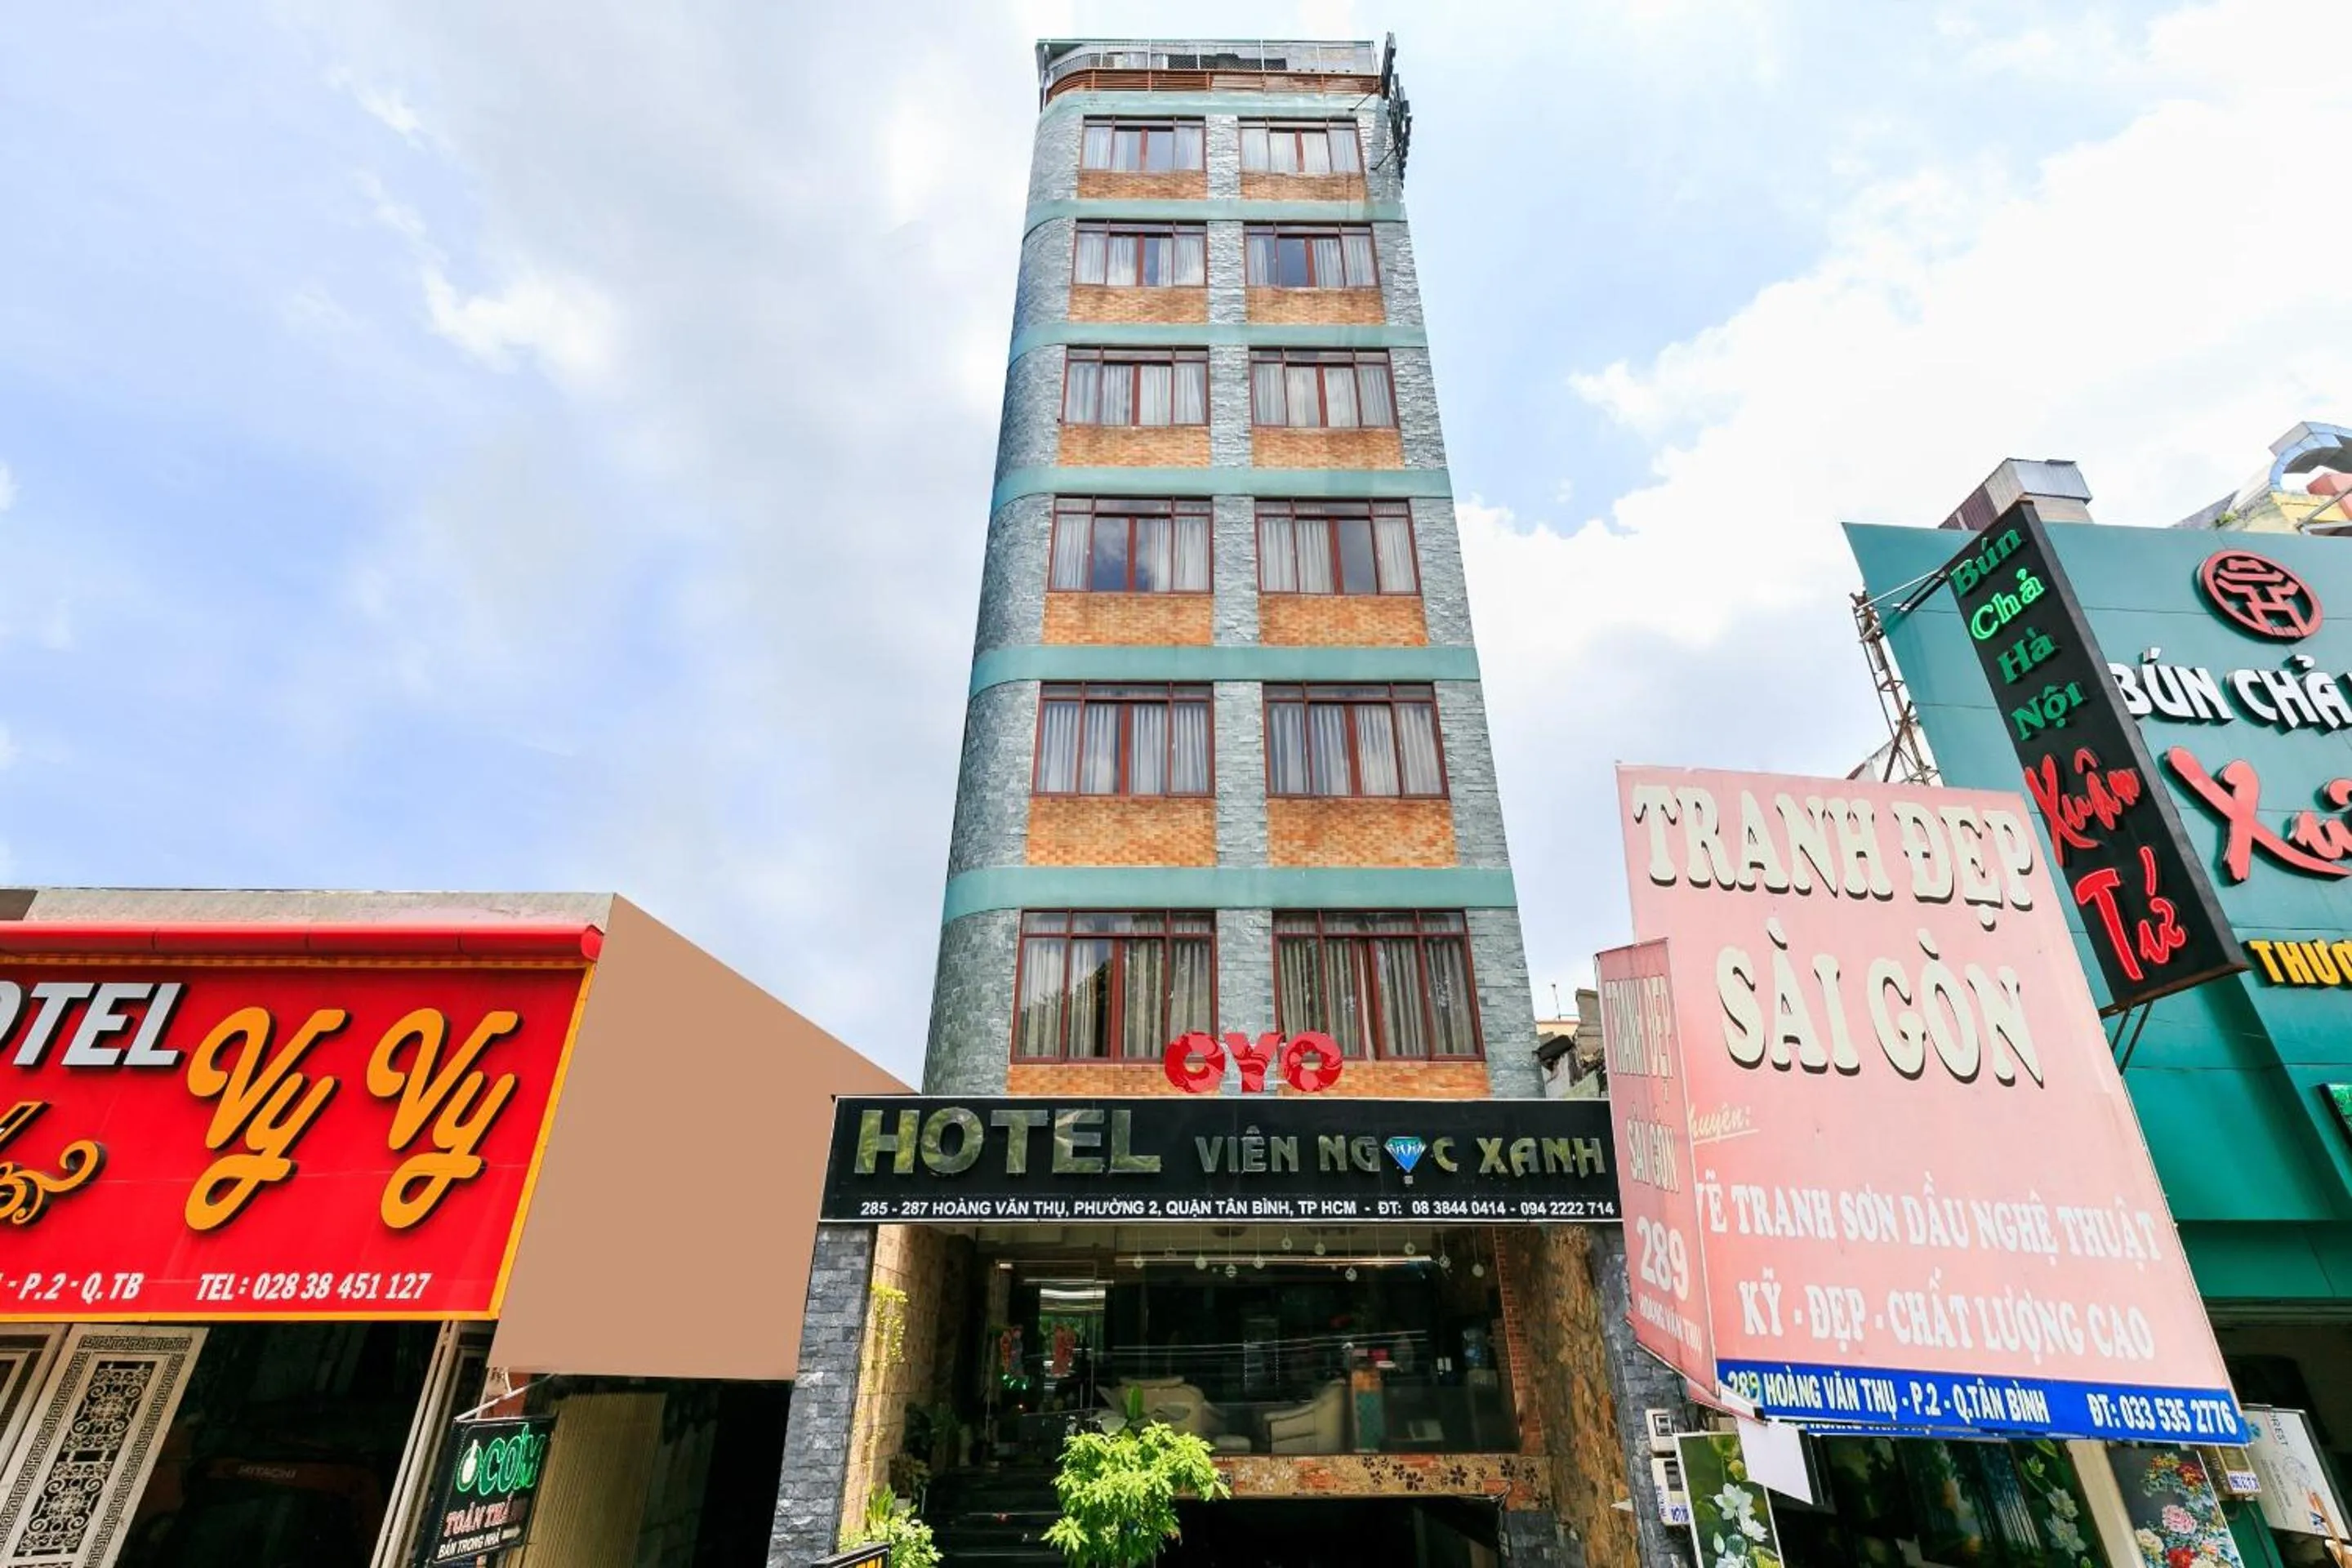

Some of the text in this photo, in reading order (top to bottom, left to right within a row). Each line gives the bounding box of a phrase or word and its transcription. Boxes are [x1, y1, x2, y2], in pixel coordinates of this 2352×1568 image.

[1950, 529, 2023, 596] Bún
[1971, 568, 2045, 640] Chả
[1997, 626, 2056, 684] Hà
[2107, 647, 2352, 728] BÚN CHẢ
[2011, 682, 2084, 741] Nội
[2024, 746, 2140, 868] Xuân
[2168, 746, 2352, 881] Xu
[1632, 784, 2034, 931] TRANH ĐẸP
[1716, 917, 2044, 1089] SÀI GÒN
[1164, 1031, 1343, 1094] OYO
[853, 1107, 1163, 1176] HOTEL
[1195, 1125, 1299, 1174] VIÊN
[1477, 1136, 1608, 1178] XANH
[860, 1200, 889, 1216] 285
[901, 1200, 929, 1216] 287
[932, 1197, 991, 1216] HOÀNG
[995, 1198, 1029, 1215] VĂN
[1033, 1200, 1069, 1218] THỤ,
[1074, 1198, 1144, 1215] PHƯỜNG
[1148, 1200, 1161, 1217] 2,
[1166, 1199, 1211, 1218] QUẬN
[1216, 1198, 1248, 1215] TÂN
[1252, 1197, 1294, 1217] BÌNH,
[1298, 1200, 1318, 1215] TP
[1321, 1200, 1357, 1215] HCM
[1378, 1200, 1402, 1215] ĐT:
[1412, 1200, 1429, 1215] 08
[1433, 1200, 1468, 1215] 3844
[1472, 1200, 1506, 1215] 0414
[1521, 1201, 1547, 1216] 094
[1550, 1201, 1585, 1216] 2222
[1587, 1201, 1615, 1216] 714
[1731, 1183, 1837, 1241] TRANH
[1839, 1183, 1900, 1243] SƠN
[1900, 1170, 1970, 1249] DẦU
[1970, 1188, 2059, 1266] NGHỆ
[2056, 1194, 2163, 1272] THUẬT
[252, 1272, 301, 1300] 028
[301, 1272, 334, 1300] 38
[336, 1272, 381, 1300] 451
[385, 1272, 432, 1300] 127
[1636, 1215, 1690, 1302] 289
[1739, 1267, 1784, 1337] KỸ
[1804, 1285, 1866, 1352] ĐẸP
[1887, 1267, 1973, 1349] CHẤT
[1973, 1285, 2084, 1365] LƯỢNG
[2087, 1303, 2155, 1361] CAO
[1762, 1365, 1823, 1410] HOÀNG
[1822, 1370, 1861, 1411] VĂN
[1860, 1377, 1899, 1421] THỤ
[1951, 1378, 2007, 1425] Q.TÂN
[2004, 1380, 2051, 1424] BÌNH
[2086, 1392, 2121, 1429] ĐT:
[2118, 1394, 2156, 1432] 033
[2154, 1396, 2193, 1433] 535
[2189, 1399, 2238, 1436] 2776
